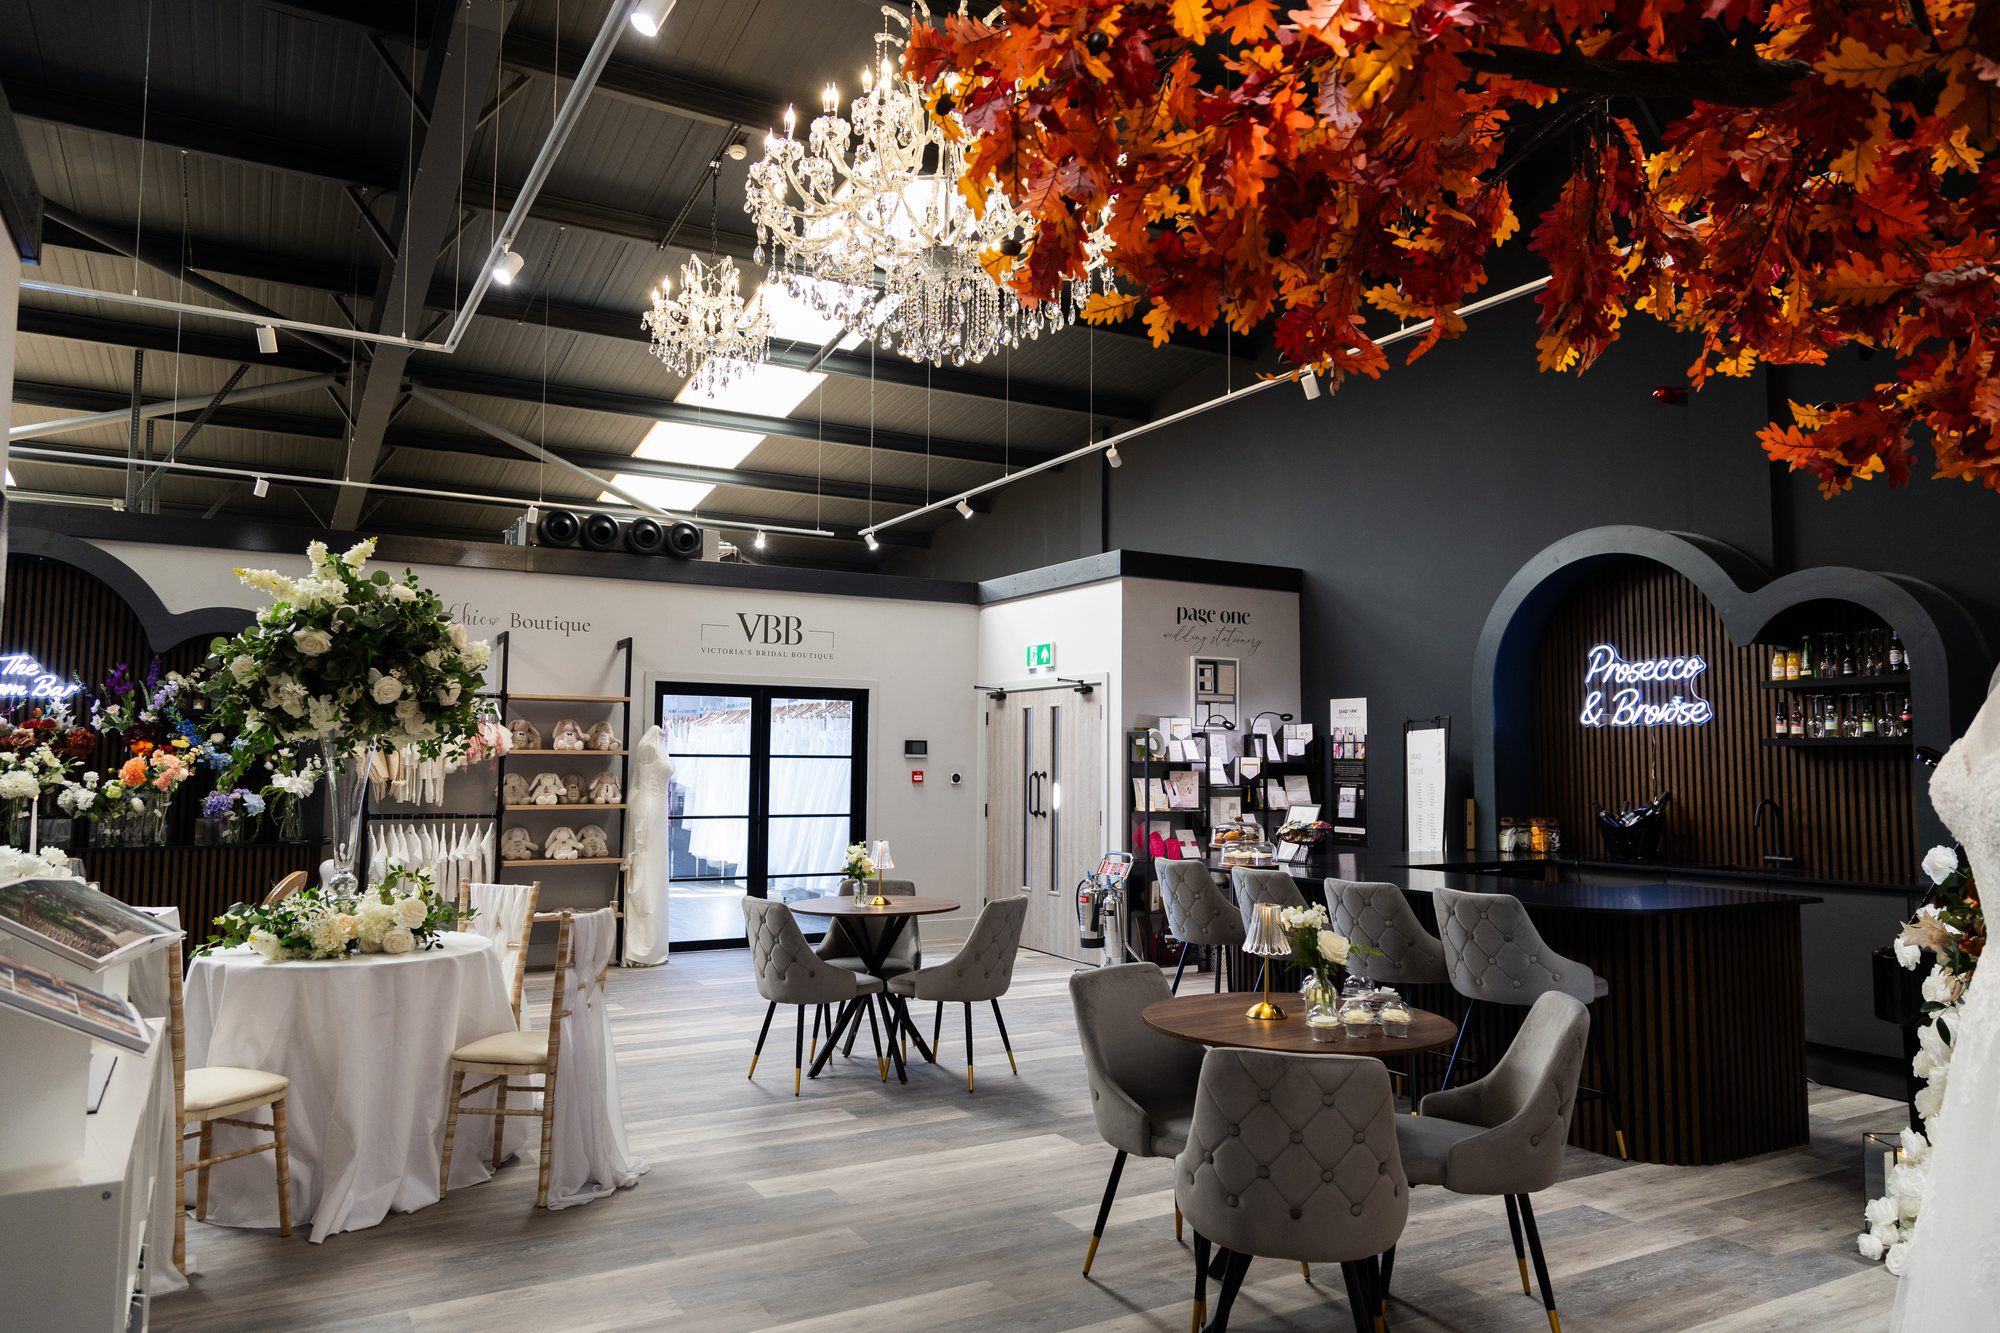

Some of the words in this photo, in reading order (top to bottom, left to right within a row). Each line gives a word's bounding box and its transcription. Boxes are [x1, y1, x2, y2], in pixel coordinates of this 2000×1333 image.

[510, 612, 591, 637] Boutique
[736, 612, 803, 645] VBB
[1176, 606, 1216, 627] page
[1220, 610, 1251, 625] one
[1163, 624, 1209, 653] wedding
[1210, 626, 1263, 656] stationery
[0, 655, 40, 676] The
[700, 646, 752, 656] VICTORIA'S
[755, 649, 788, 658] BRIDAL
[791, 651, 834, 660] BOUTIQUE
[1586, 645, 1704, 683] Prosecco
[31, 674, 79, 697] Bar
[1580, 690, 1603, 725] &
[1611, 688, 1710, 725] Browse
